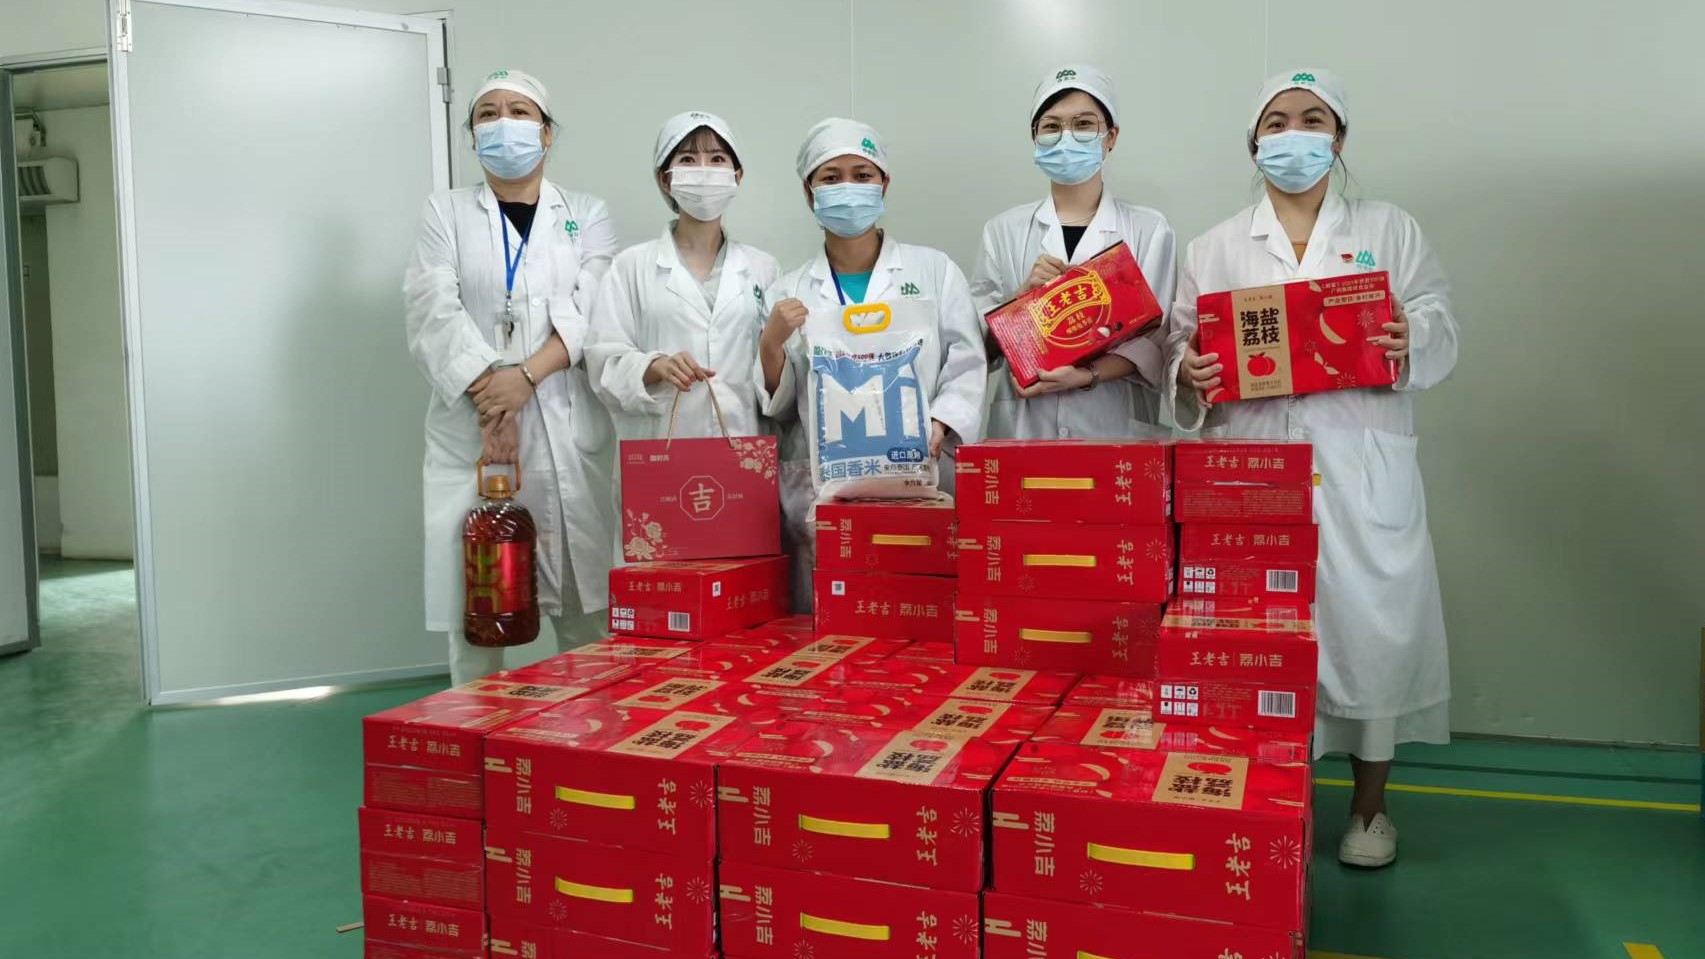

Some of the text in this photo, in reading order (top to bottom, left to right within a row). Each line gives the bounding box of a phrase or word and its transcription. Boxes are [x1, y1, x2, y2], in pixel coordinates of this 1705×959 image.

[1047, 284, 1088, 318] 王老吉
[1240, 307, 1279, 327] 海盐
[1242, 326, 1280, 346] 荔枝
[984, 459, 1000, 505] 荔小吉
[1115, 460, 1132, 506] 王老吉
[1204, 456, 1239, 468] 王老吉
[689, 483, 715, 513] 吉
[986, 536, 1001, 582] 荔小吉
[1117, 540, 1133, 585] 王老吉
[1211, 534, 1245, 546] 王老吉
[855, 600, 938, 618] 王老吉 荔小吉
[983, 608, 998, 654] 荔小吉
[1112, 616, 1129, 662] 王老吉
[1190, 652, 1283, 667] 王老吉 荔小吉
[387, 735, 418, 751] 王老吉
[515, 757, 532, 814] 荔小吉
[657, 778, 677, 835] 王老吉
[384, 824, 415, 840] 王老吉
[753, 786, 771, 846] 荔小吉
[916, 805, 938, 866] 王老吉
[1033, 811, 1055, 877] 荔小吉
[1225, 833, 1251, 901] 王老吉
[515, 848, 532, 904] 荔小吉
[388, 914, 418, 930] 王老吉
[655, 873, 673, 930] 王老吉
[755, 885, 773, 945] 荔小吉
